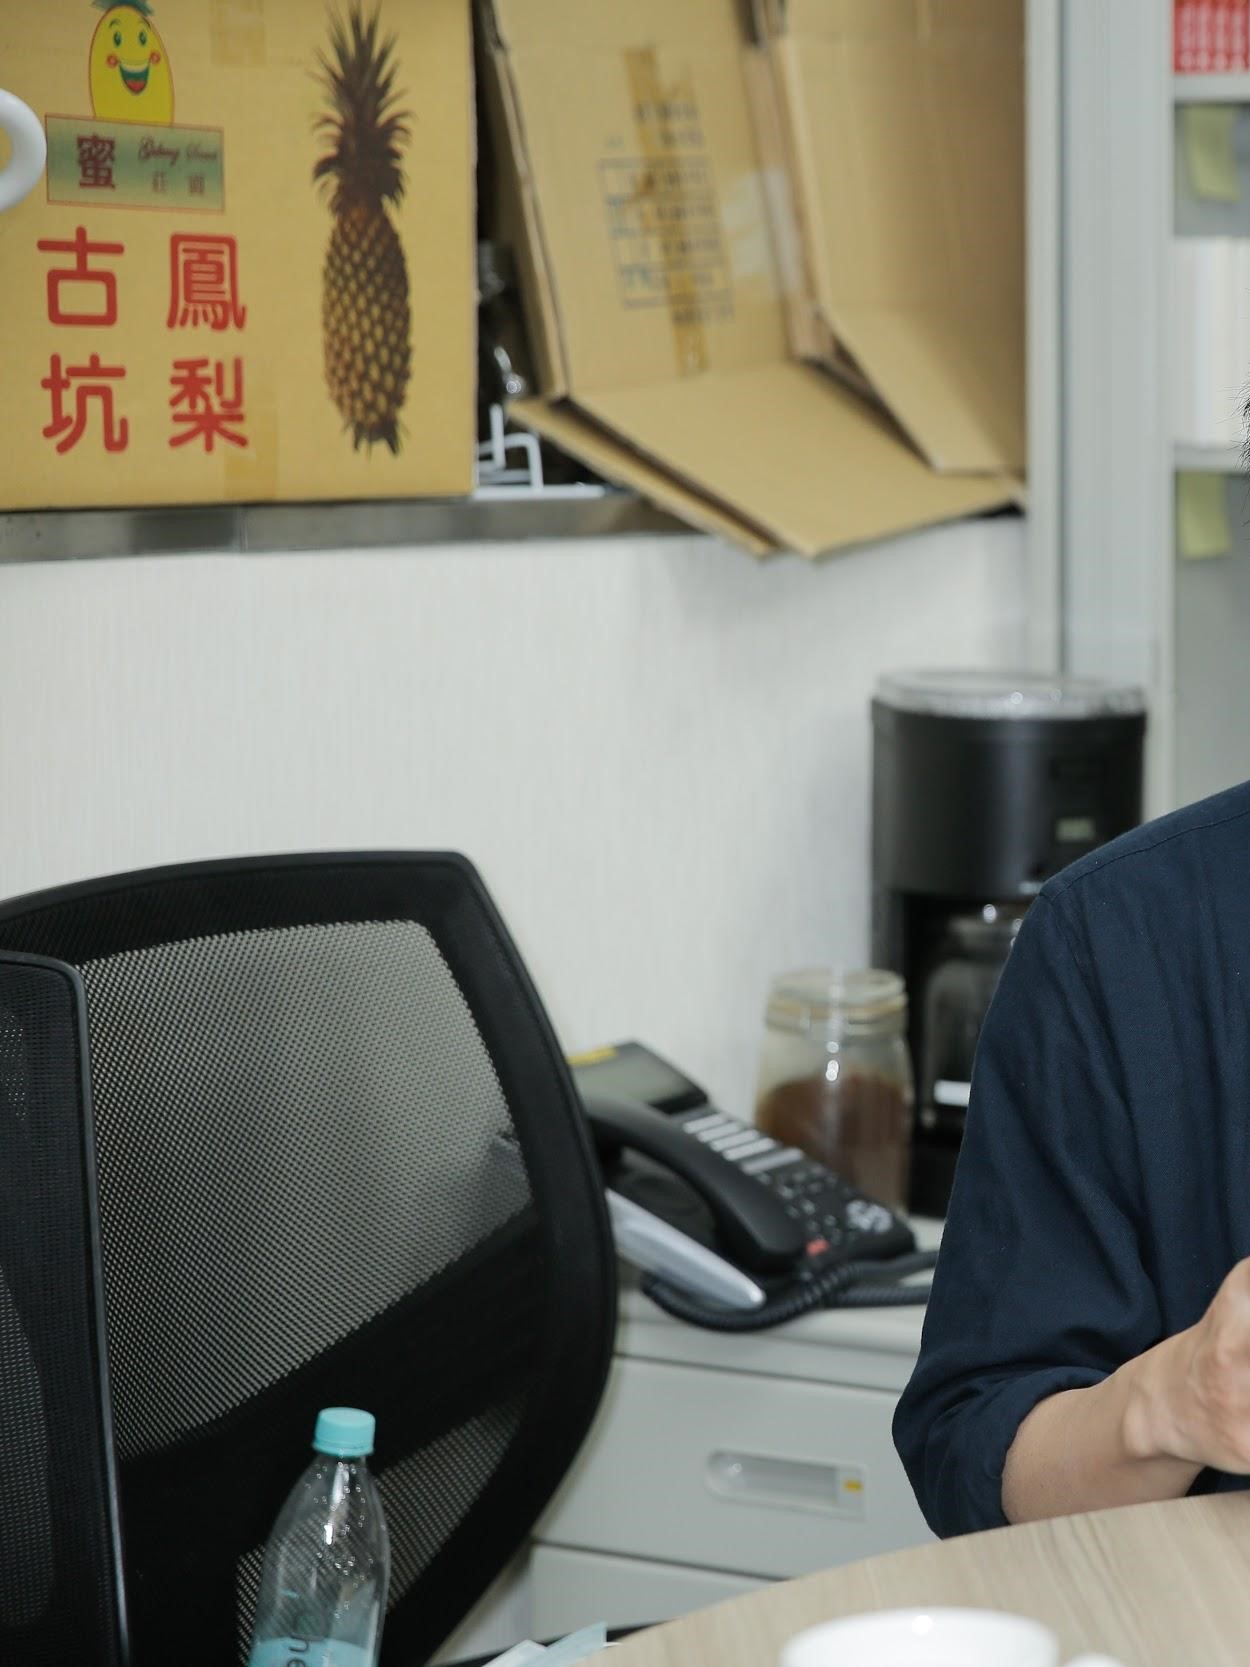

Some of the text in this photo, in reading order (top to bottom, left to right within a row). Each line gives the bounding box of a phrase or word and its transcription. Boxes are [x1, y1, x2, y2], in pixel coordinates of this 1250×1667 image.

[76, 134, 116, 191] 蜜
[36, 225, 128, 454] 古坑
[166, 233, 246, 453] 鳳梨
